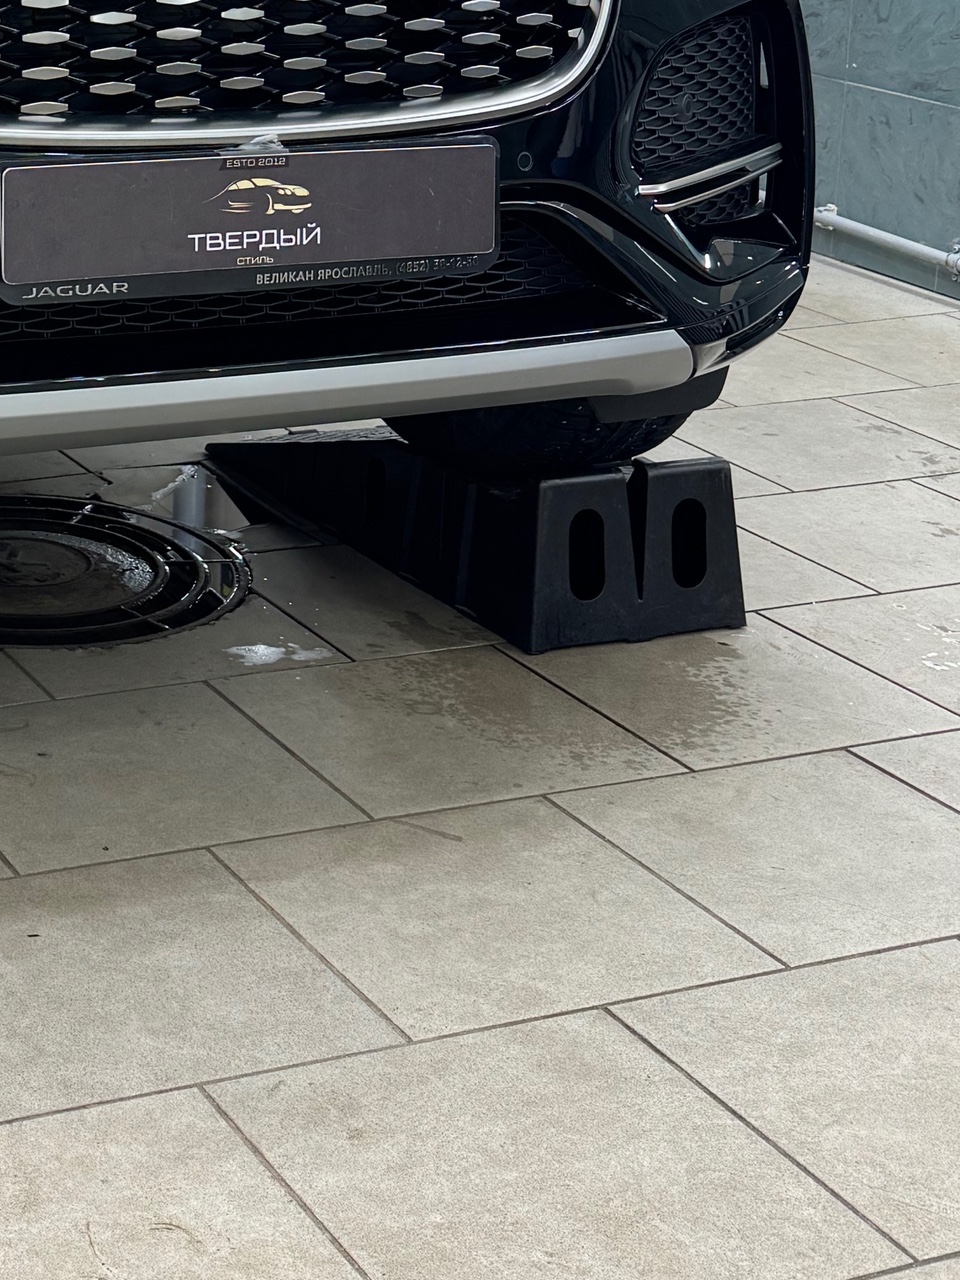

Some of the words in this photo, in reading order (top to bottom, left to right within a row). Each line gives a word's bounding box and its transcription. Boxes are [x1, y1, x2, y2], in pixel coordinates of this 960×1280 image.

[258, 156, 286, 167] 2012
[187, 222, 321, 252] ТВЕРДЫЙ
[256, 268, 314, 285] ВЕЛИКАН
[22, 282, 129, 299] JAGUAR
